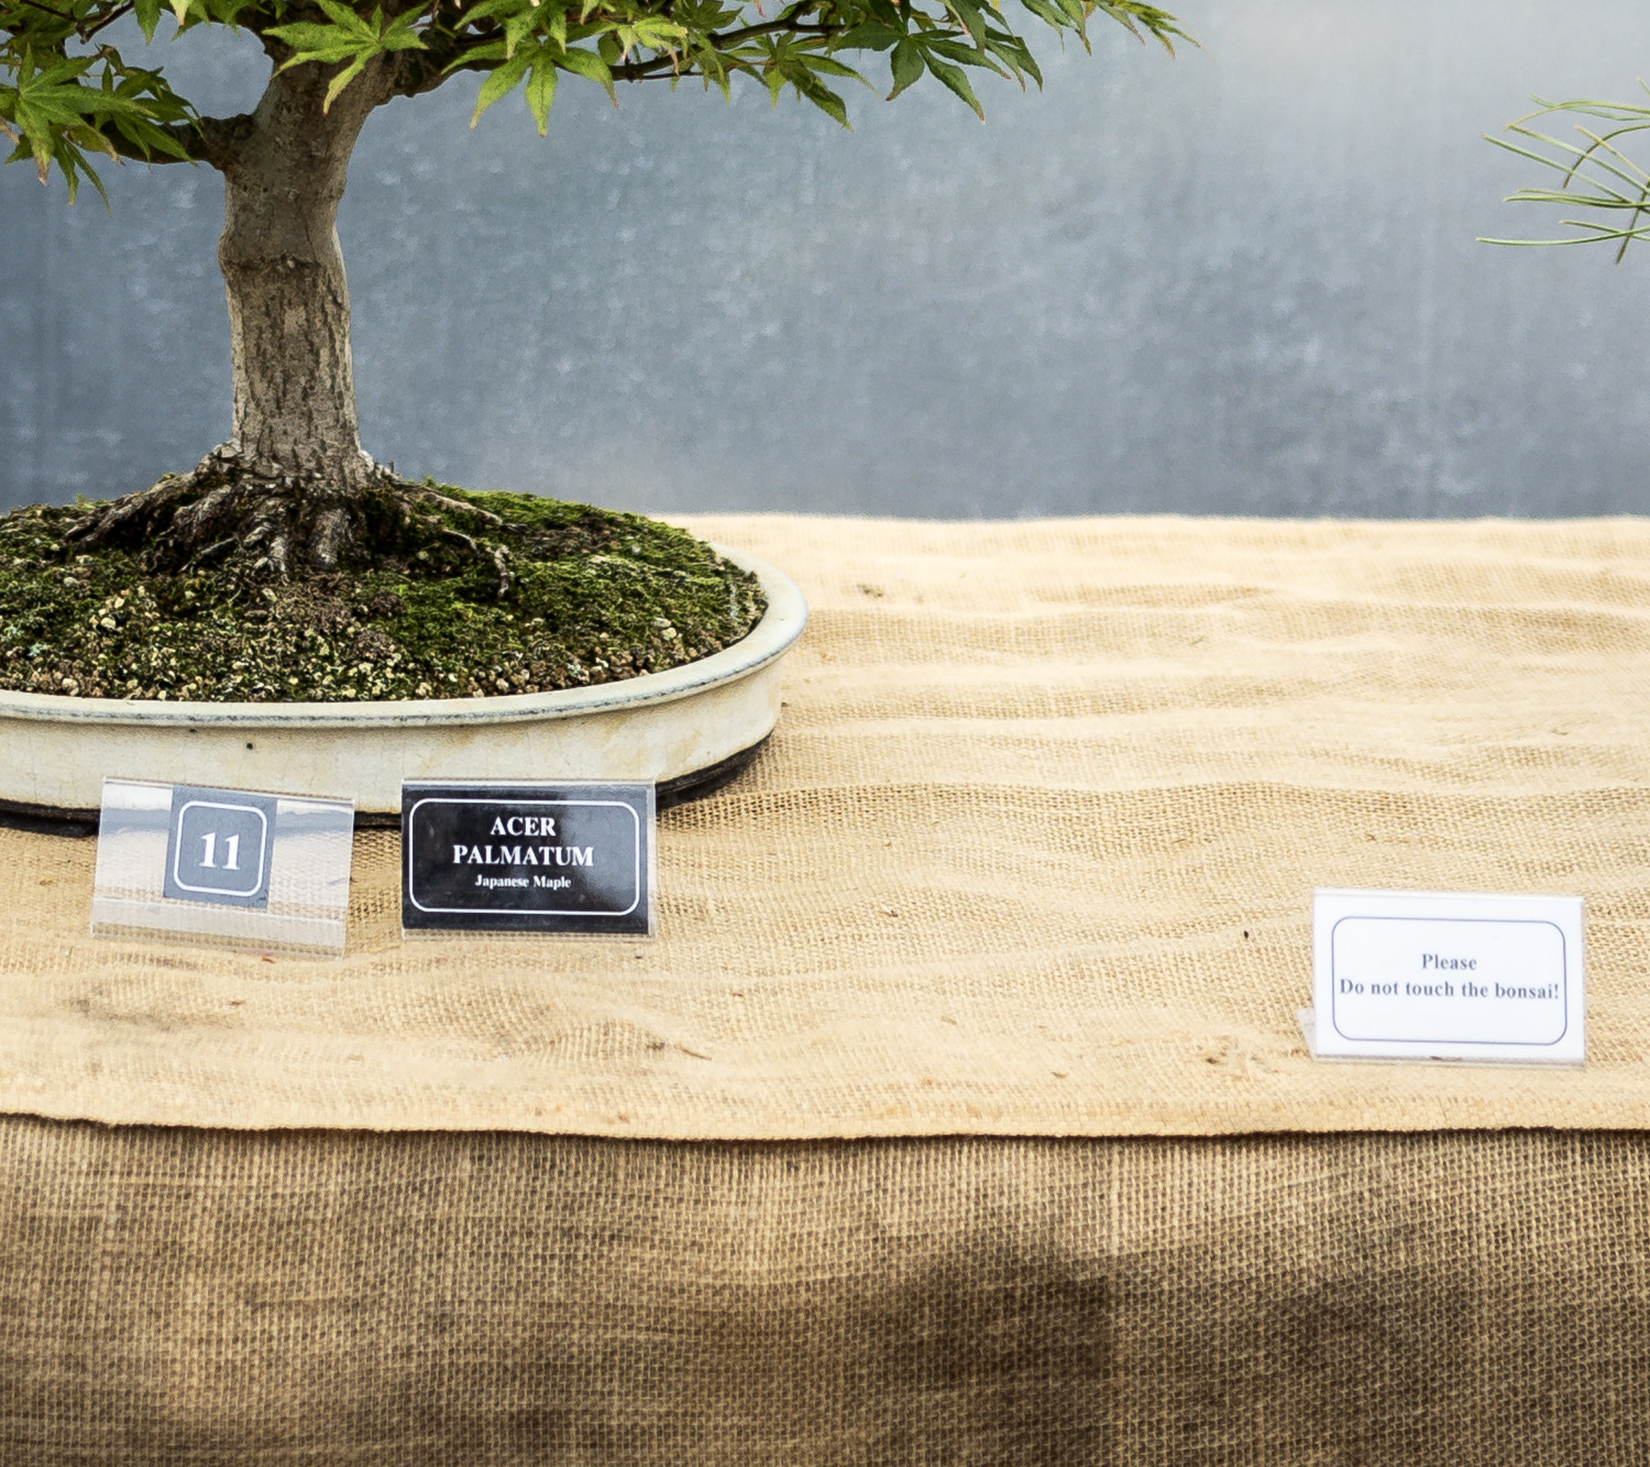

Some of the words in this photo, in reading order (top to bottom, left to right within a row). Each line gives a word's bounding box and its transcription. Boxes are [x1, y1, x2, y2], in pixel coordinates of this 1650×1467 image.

[490, 817, 556, 836] ACER
[198, 832, 241, 870] 11
[453, 845, 594, 867] PALMATUM
[475, 874, 530, 890] Japanese
[533, 875, 572, 891] Maple
[1421, 953, 1478, 970] Please
[1339, 979, 1364, 995] Do
[1371, 981, 1399, 996] not
[1406, 981, 1455, 997] touch
[1461, 982, 1489, 998] the
[1495, 983, 1559, 1000] bonsai!
